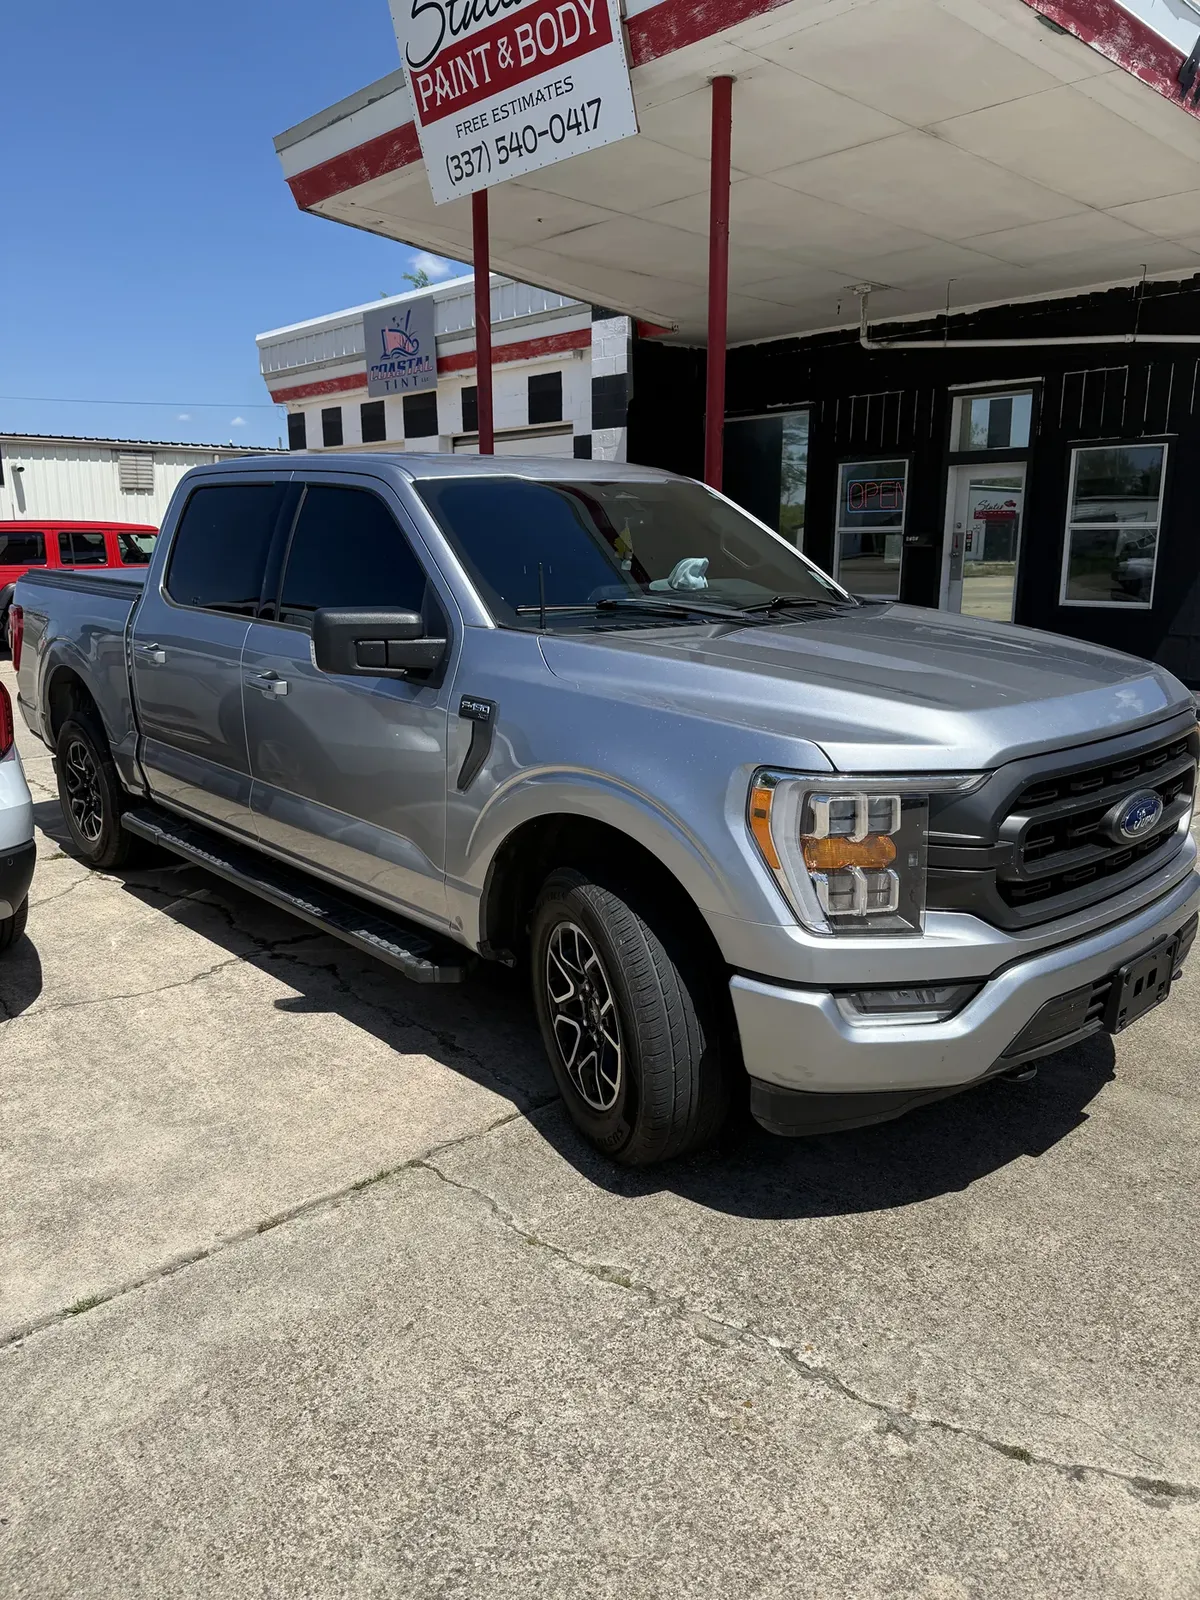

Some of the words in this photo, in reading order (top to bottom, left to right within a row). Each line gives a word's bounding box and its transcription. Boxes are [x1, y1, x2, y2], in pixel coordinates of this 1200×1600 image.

[405, 0, 522, 68] Stu
[416, 41, 491, 113] PAINT
[497, 36, 514, 69] &
[514, 0, 598, 67] BODY
[455, 113, 490, 138] FREE
[491, 75, 574, 123] ESTIMATES
[445, 140, 491, 186] (337)
[494, 98, 602, 165] 540-0417
[370, 356, 433, 381] COASTAL
[385, 376, 418, 390] TINT
[1133, 805, 1156, 830] Ford
